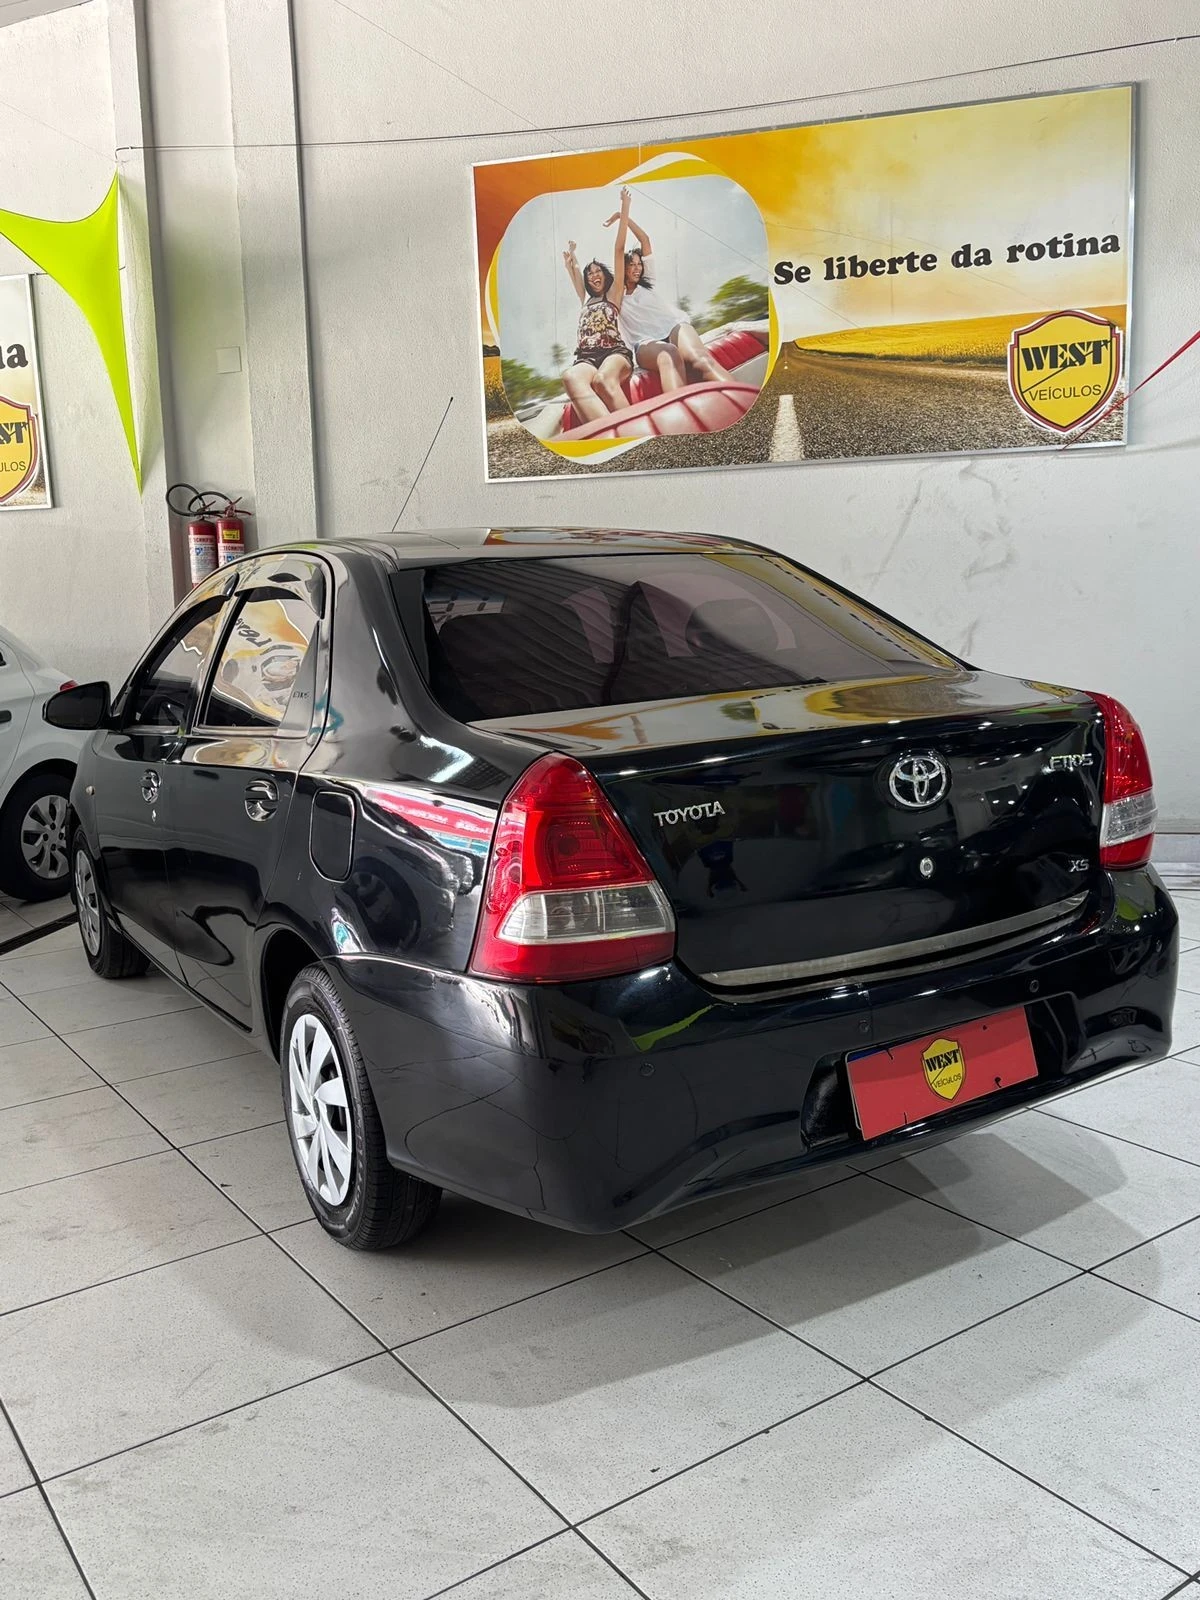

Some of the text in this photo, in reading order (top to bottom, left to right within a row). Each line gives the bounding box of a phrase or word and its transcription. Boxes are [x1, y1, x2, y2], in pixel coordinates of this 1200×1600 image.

[774, 232, 1121, 285] Se liberte da rotina
[1021, 339, 1109, 371] WEST
[1029, 384, 1102, 401] VEÍCULOS
[1050, 753, 1093, 772] ETIOS
[653, 801, 725, 826] TOYOTA
[1069, 859, 1089, 872] XS
[925, 1049, 960, 1072] WEST
